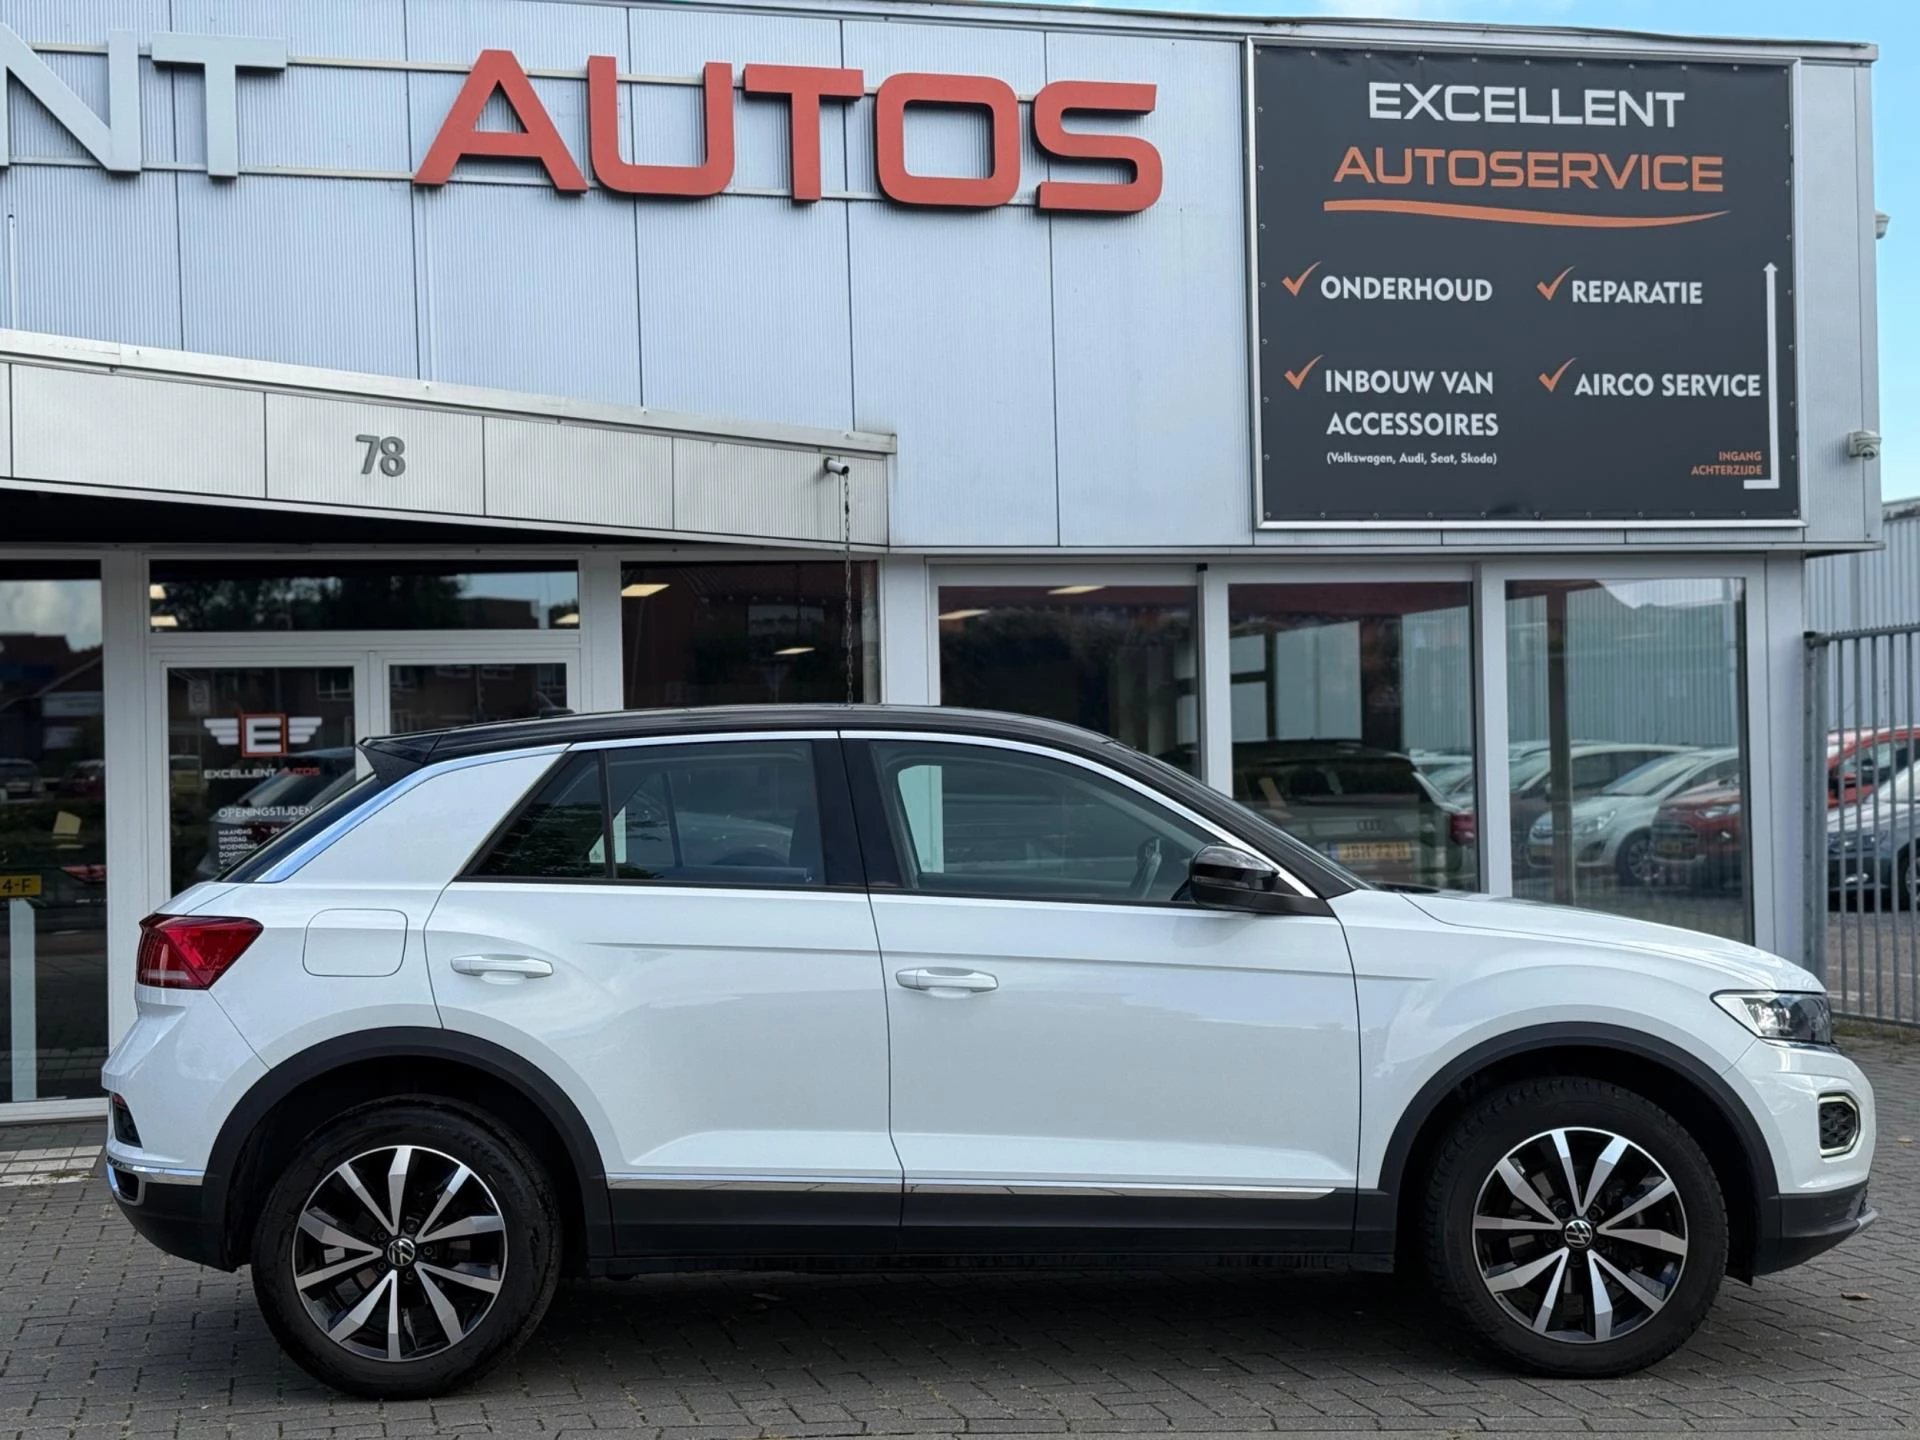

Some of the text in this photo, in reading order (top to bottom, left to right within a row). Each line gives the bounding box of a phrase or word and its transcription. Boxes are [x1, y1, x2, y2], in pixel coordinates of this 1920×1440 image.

[1368, 82, 1685, 127] EXCELLENT
[413, 49, 1163, 212] AUTOS
[1333, 146, 1724, 192] AUTOSERVICE
[1321, 276, 1493, 302] ONDERHOUD
[1572, 281, 1704, 305] REPARATIE
[1326, 370, 1494, 394] INBOUW VAN
[1574, 373, 1761, 397] AIRCO SERVICE
[1326, 412, 1499, 436] ACCESSOIRES
[355, 433, 406, 477] 78
[1327, 451, 1497, 465] (Volkswagen, Audi, Seat, Skoda)
[1719, 452, 1762, 463] INGANG
[1691, 466, 1763, 476] ACHTERZIJDE
[246, 717, 282, 752] E
[204, 767, 320, 780] EXCELLENT AUTOS
